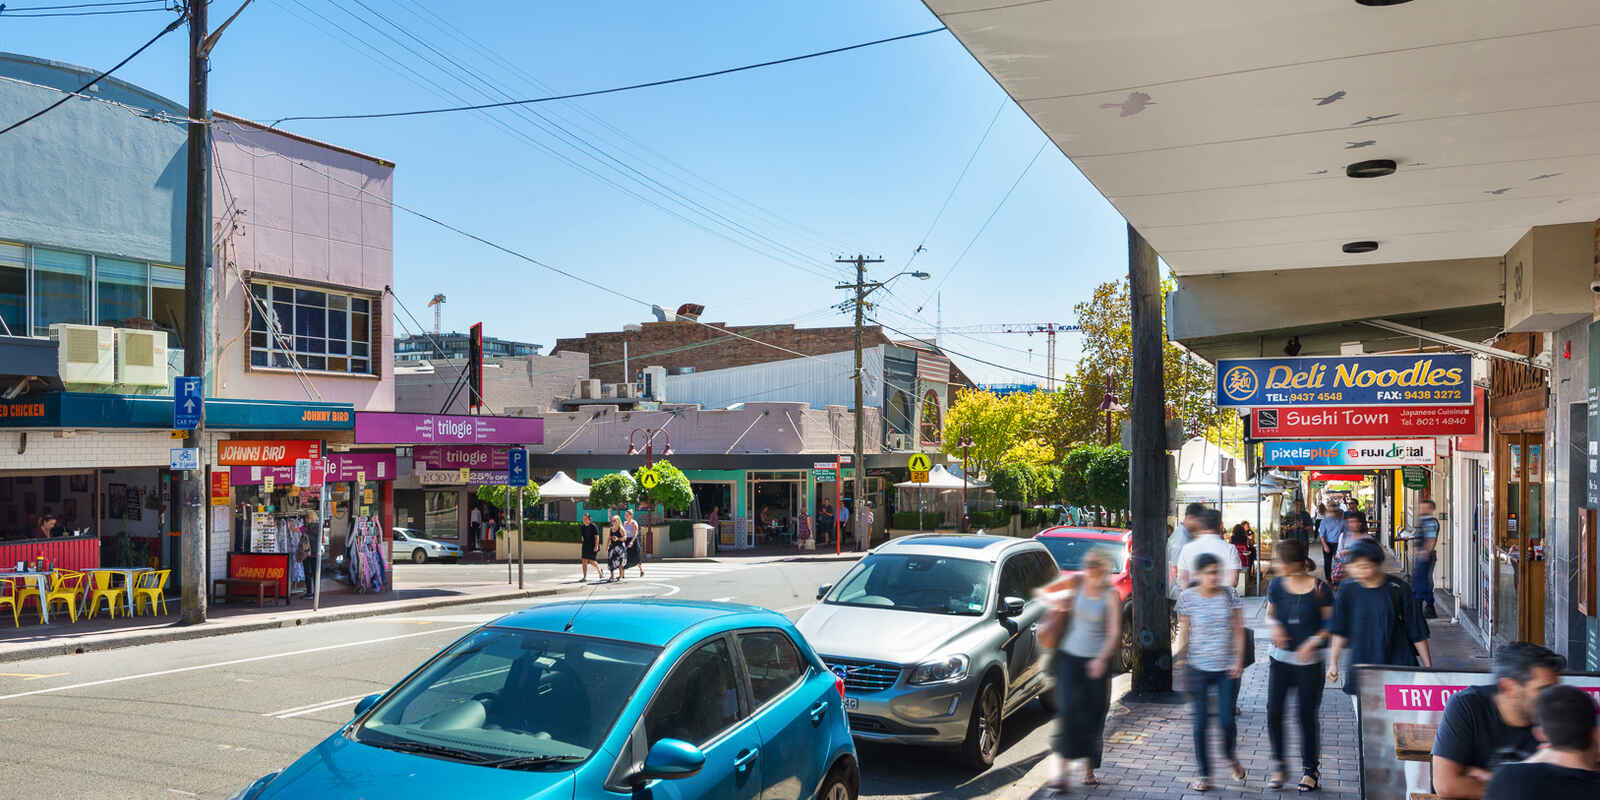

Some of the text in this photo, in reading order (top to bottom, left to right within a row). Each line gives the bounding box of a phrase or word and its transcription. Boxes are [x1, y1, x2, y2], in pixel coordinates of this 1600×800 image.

[1264, 363, 1327, 389] Deli
[1333, 359, 1464, 388] Noodles
[184, 382, 195, 396] P
[1377, 390, 1461, 400] FAX: 9438 3272
[1265, 392, 1342, 402] TEL: 9437 4548
[10, 403, 45, 417] CHICKEN
[301, 410, 349, 422] JOHNNY BIRD
[1287, 410, 1389, 426] Sushi Town
[438, 420, 472, 438] trilogie
[221, 445, 286, 462] JOHNNY BIRD
[447, 450, 488, 465] trilogie
[513, 453, 521, 463] P
[1271, 447, 1339, 460] pixelsplus
[1361, 443, 1423, 459] FUJI digital
[1398, 689, 1432, 707] TRY
